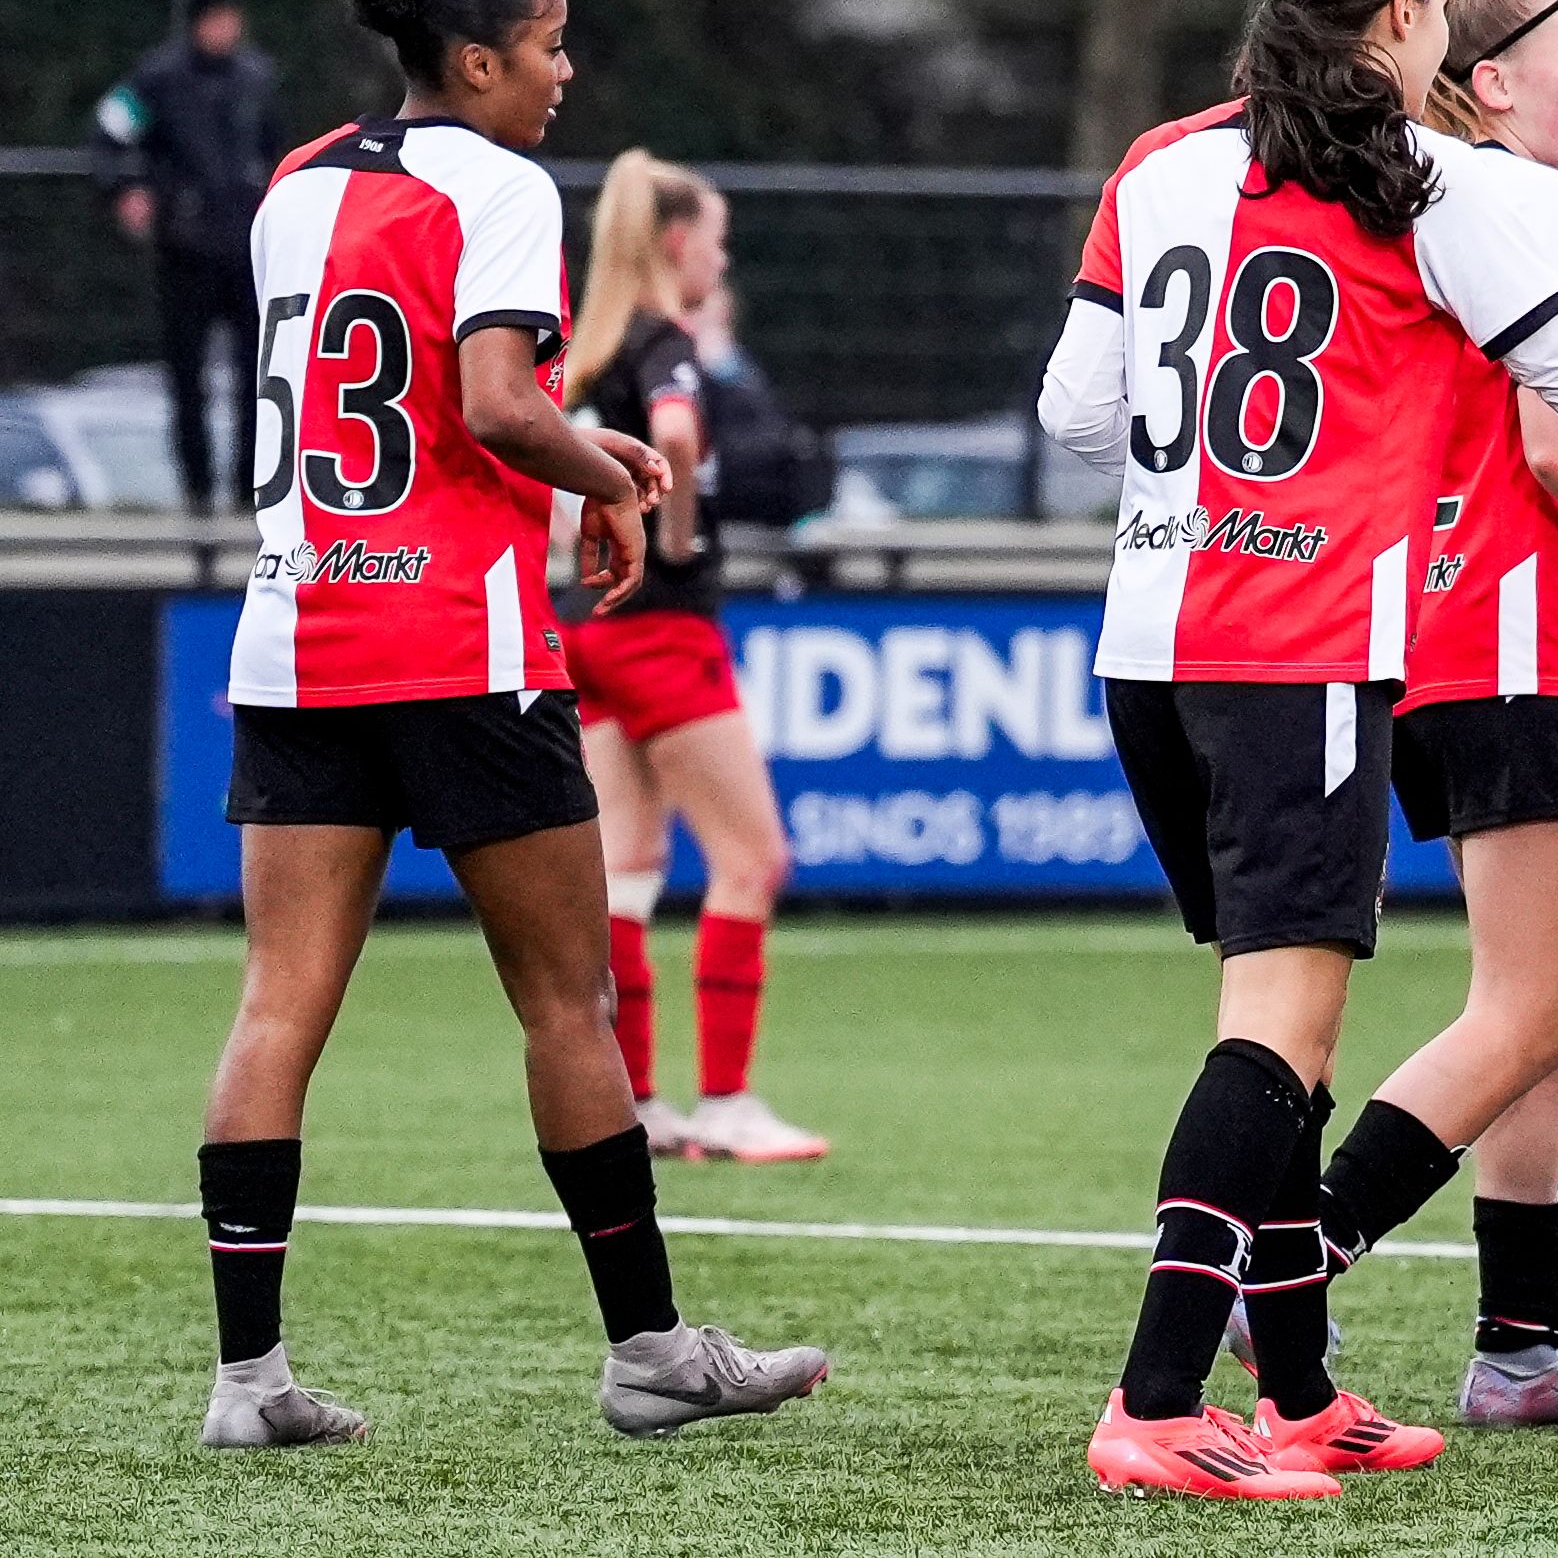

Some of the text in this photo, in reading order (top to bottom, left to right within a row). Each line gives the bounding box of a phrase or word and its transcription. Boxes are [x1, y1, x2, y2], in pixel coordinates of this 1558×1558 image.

[253, 288, 416, 516] 53
[1130, 245, 1339, 482] 38
[311, 539, 431, 584] Markt
[1203, 507, 1328, 563] Markt
